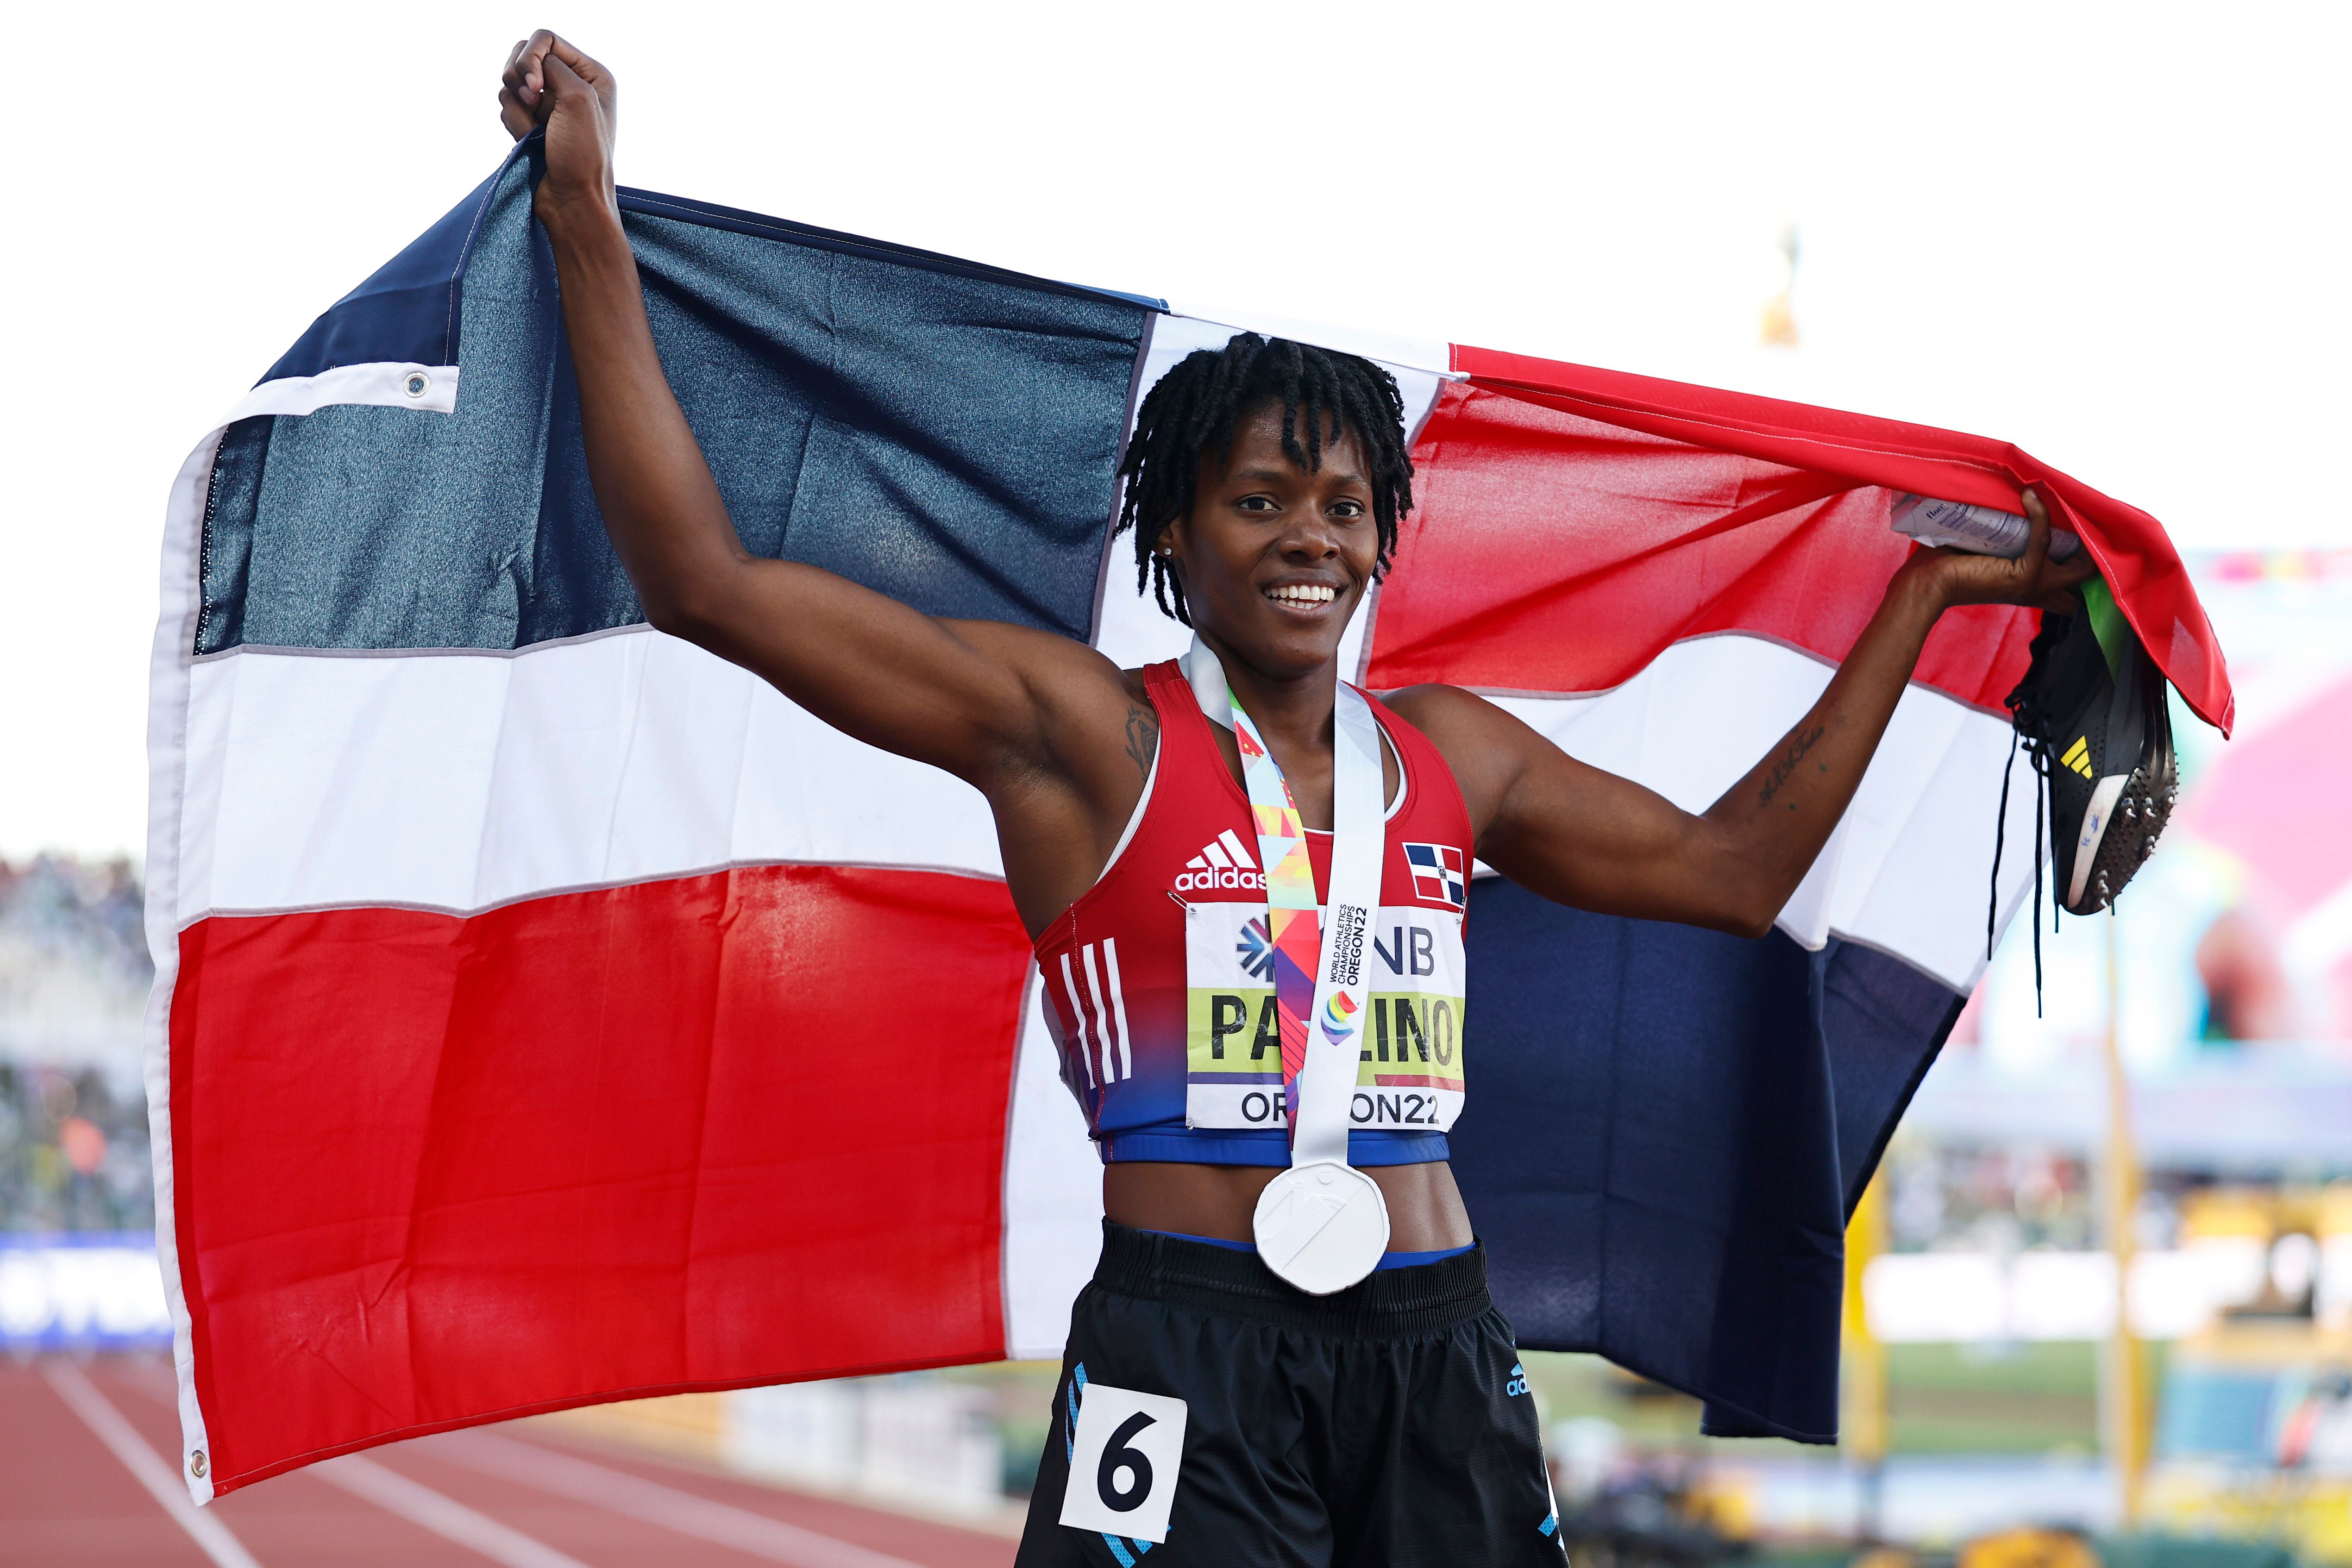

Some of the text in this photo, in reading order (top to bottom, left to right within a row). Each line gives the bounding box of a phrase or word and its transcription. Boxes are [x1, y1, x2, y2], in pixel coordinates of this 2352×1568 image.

[1330, 904, 1347, 982] WORLD ATHLETICS
[1338, 906, 1355, 984] CHAMPIONSHIPS
[1212, 995, 1452, 1066] PAINO
[1242, 1092, 1439, 1124] ORON22
[1097, 1411, 1157, 1512] 6
